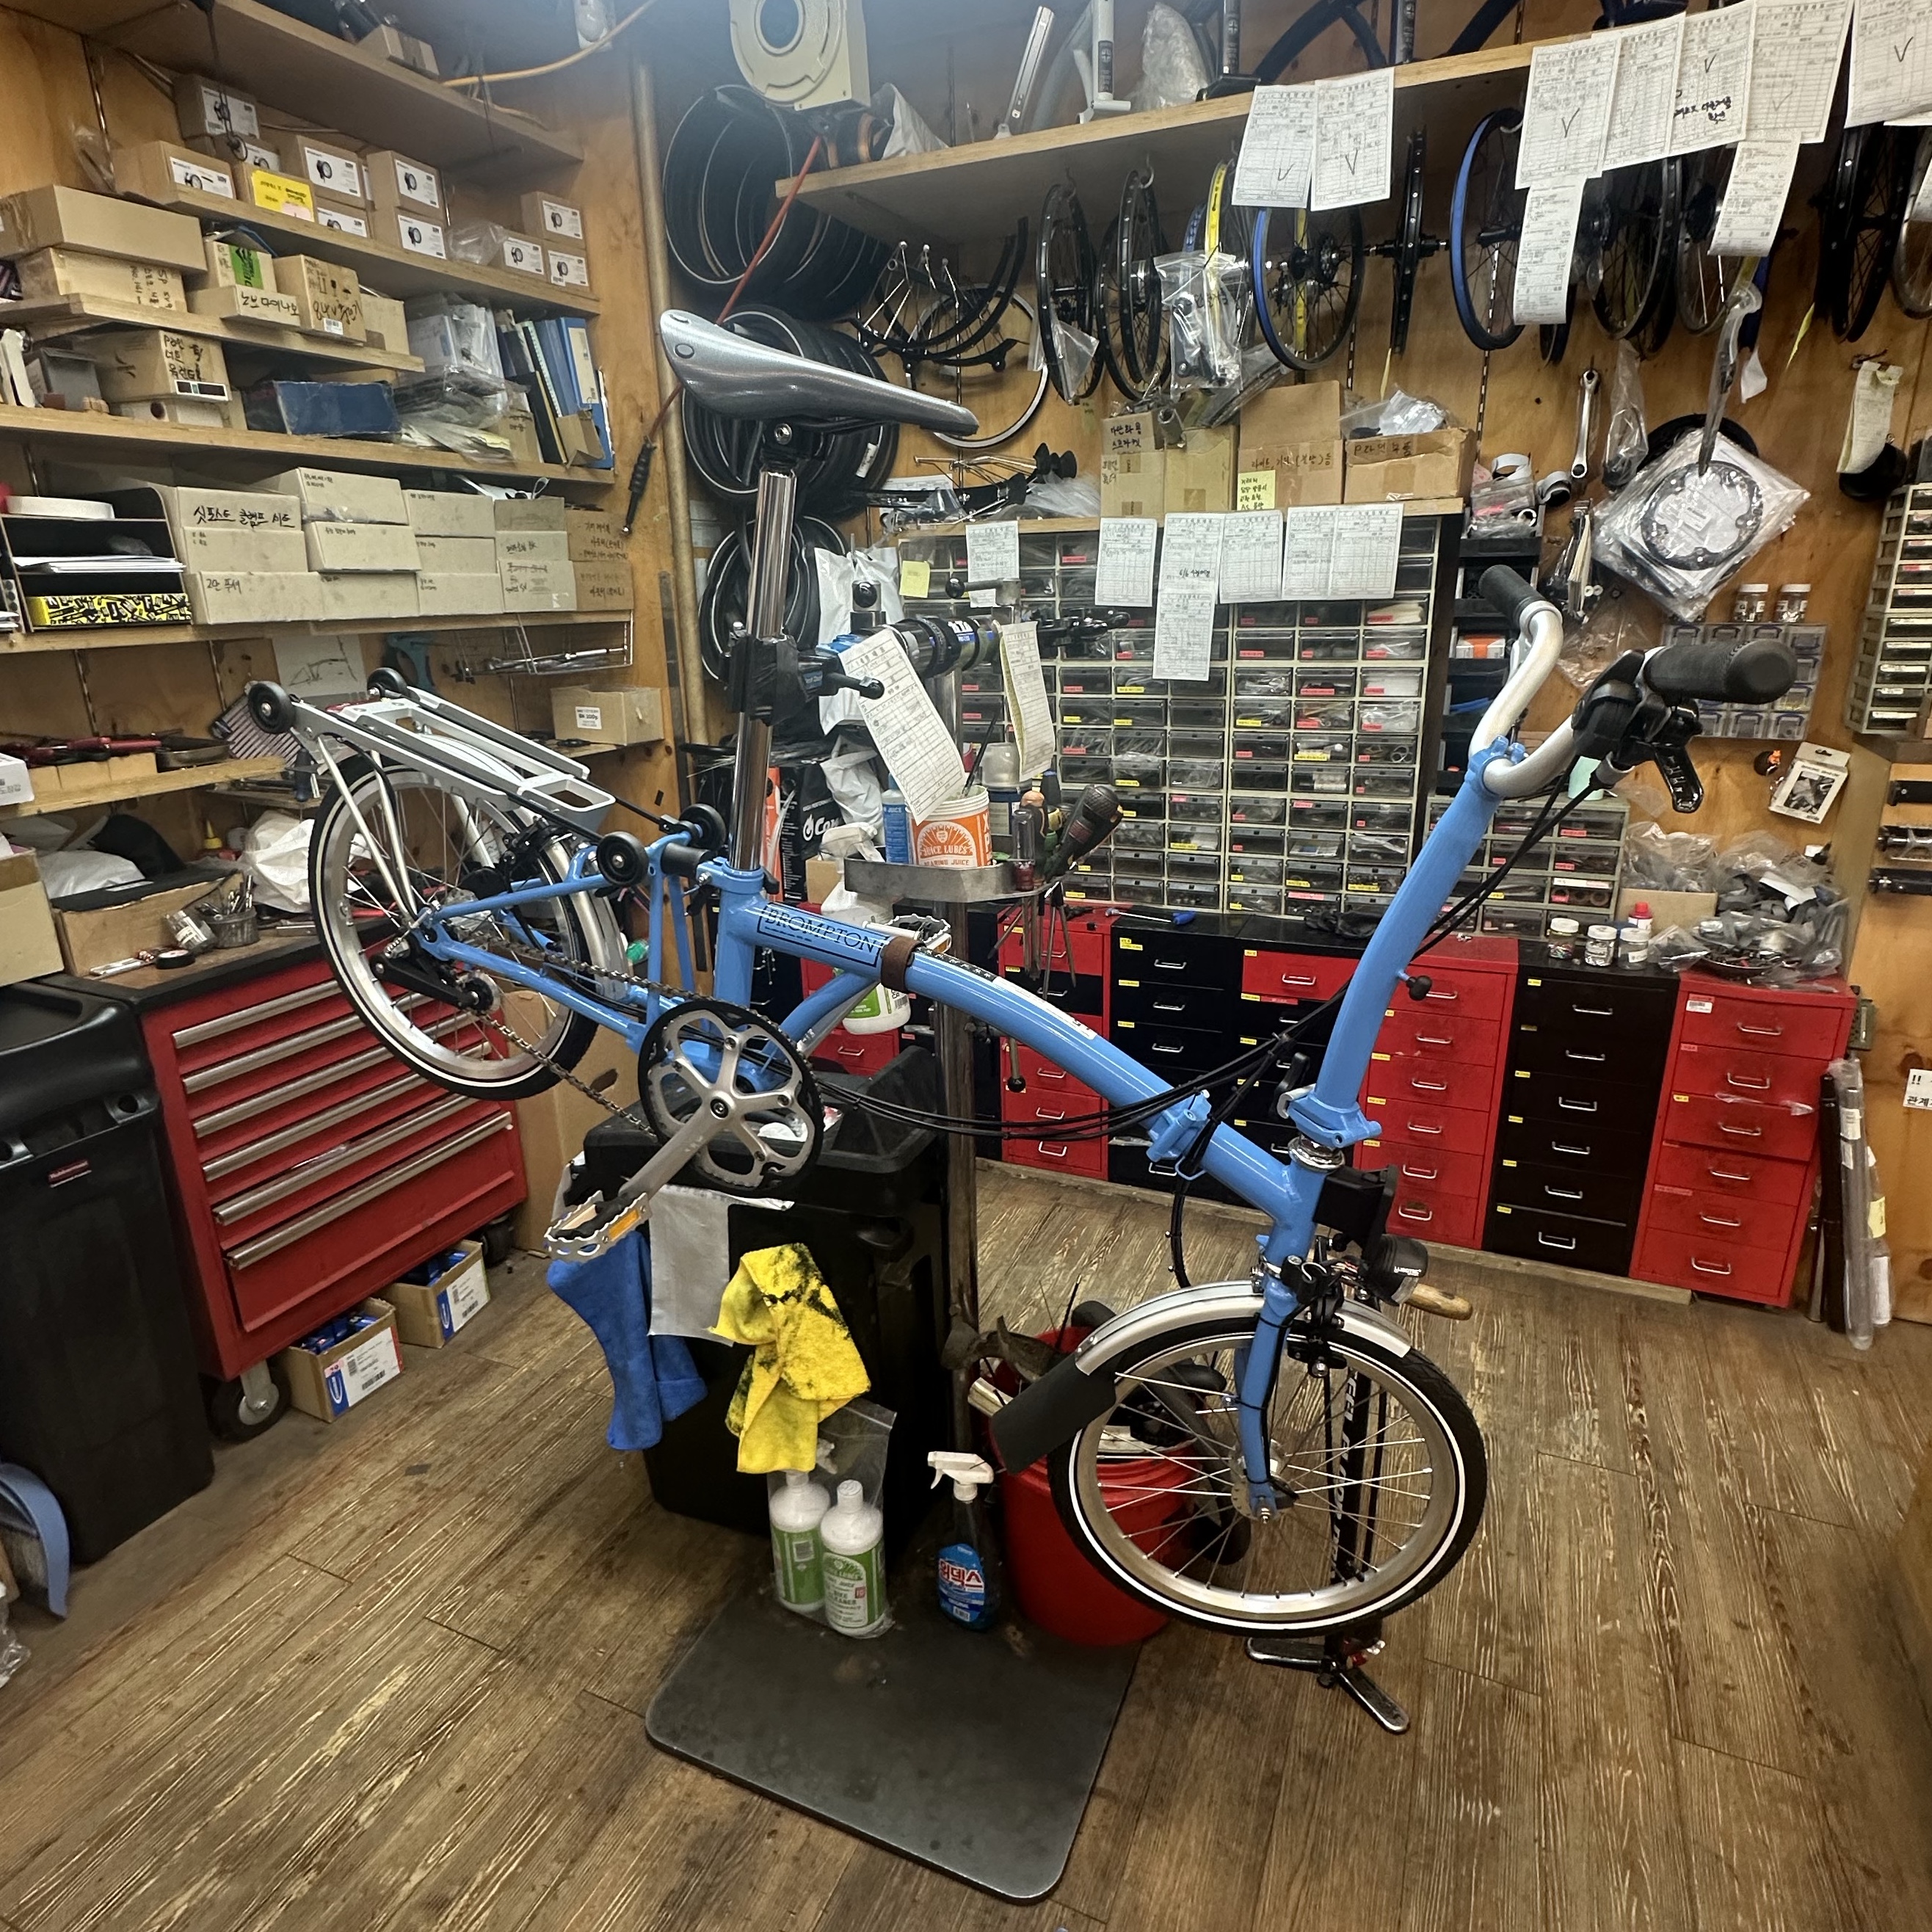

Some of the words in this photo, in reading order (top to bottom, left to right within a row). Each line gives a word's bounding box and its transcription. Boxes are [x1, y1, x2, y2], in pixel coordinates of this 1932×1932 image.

[923, 846, 943, 856] JUICE
[944, 844, 968, 855] LUBES
[765, 908, 876, 954] BROMPTON
[1907, 1095, 1932, 1107] 관계
